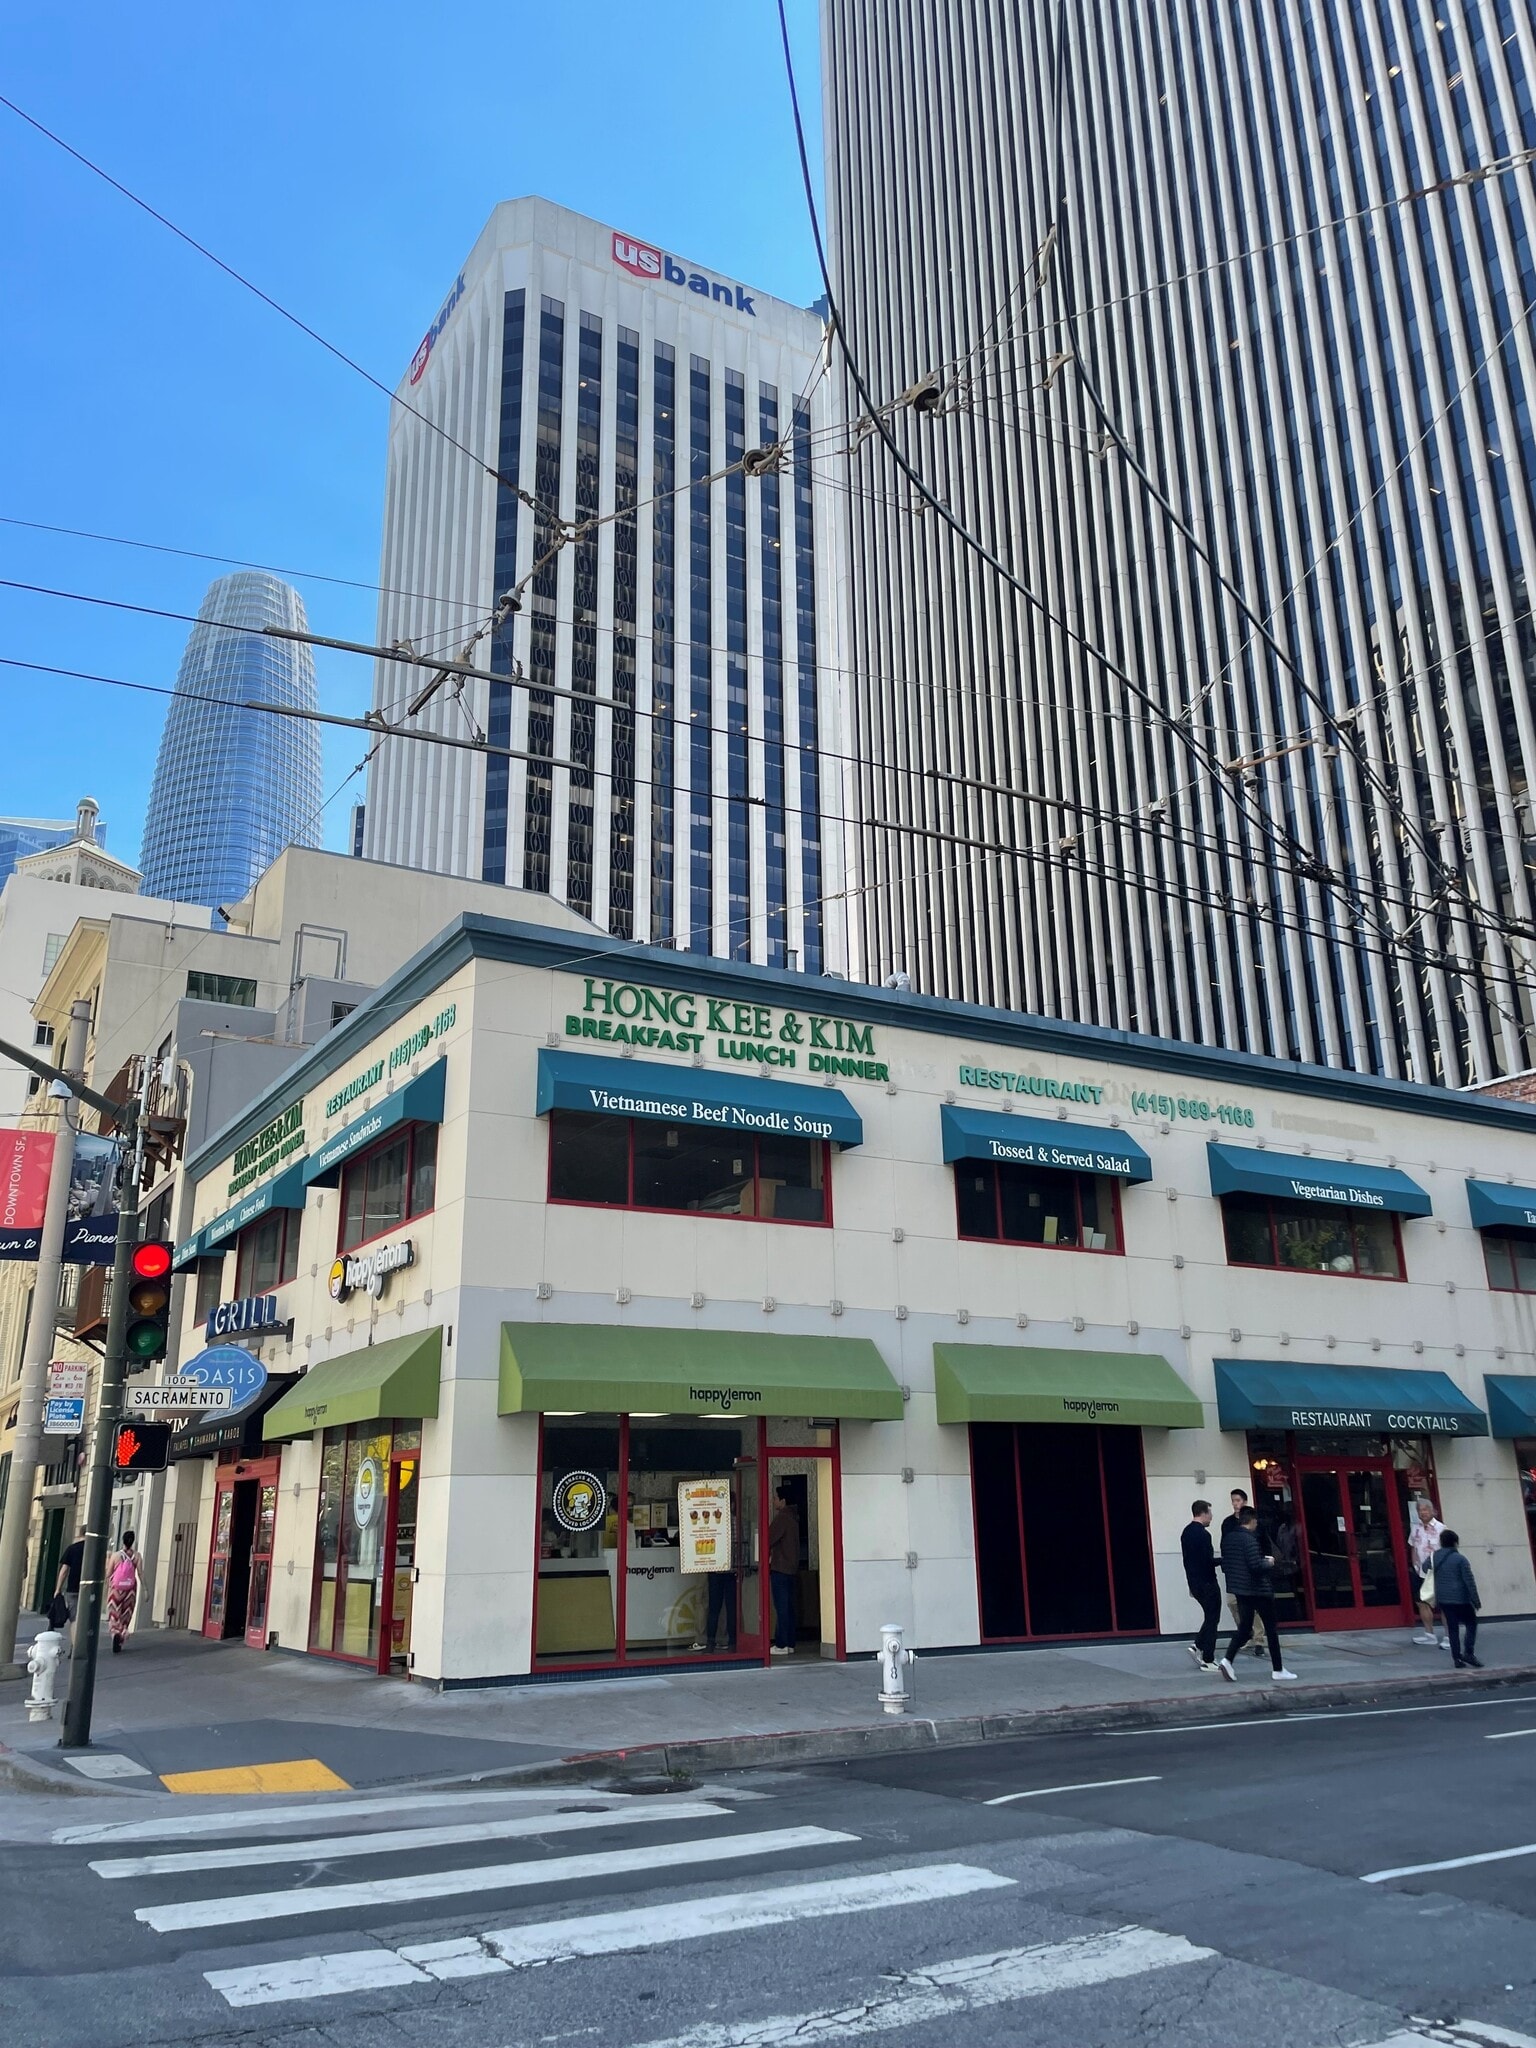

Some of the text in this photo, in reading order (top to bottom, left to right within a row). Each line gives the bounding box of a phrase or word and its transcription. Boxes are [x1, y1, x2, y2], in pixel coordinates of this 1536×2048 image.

[582, 978, 876, 1055] HONG KEE & KIM
[565, 1014, 890, 1082] BREAKFAST LUNCH DINNER
[325, 1059, 385, 1119] RESTAURANT
[959, 1064, 1104, 1105] RESTAURANT
[1130, 1090, 1176, 1122] (415)
[1177, 1097, 1255, 1128] 989-1168
[589, 1088, 834, 1138] Vietnamese Beef Noodle Soup
[989, 1139, 1131, 1174] Tossed & Served Salad
[3, 1139, 26, 1226] DOWNTOWN SF
[1290, 1180, 1384, 1206] Vegetarian Dishes
[24, 1238, 37, 1249] to
[214, 1294, 275, 1335] GRILL
[64, 1364, 87, 1373] PARKING
[168, 1376, 187, 1384] 100
[193, 1367, 256, 1385] OASIS
[134, 1391, 224, 1405] SACRAMENTO
[689, 1386, 762, 1410] happylemon
[1062, 1397, 1120, 1419] happylemon
[1291, 1411, 1459, 1431] RESTAURANT COCKTAILS
